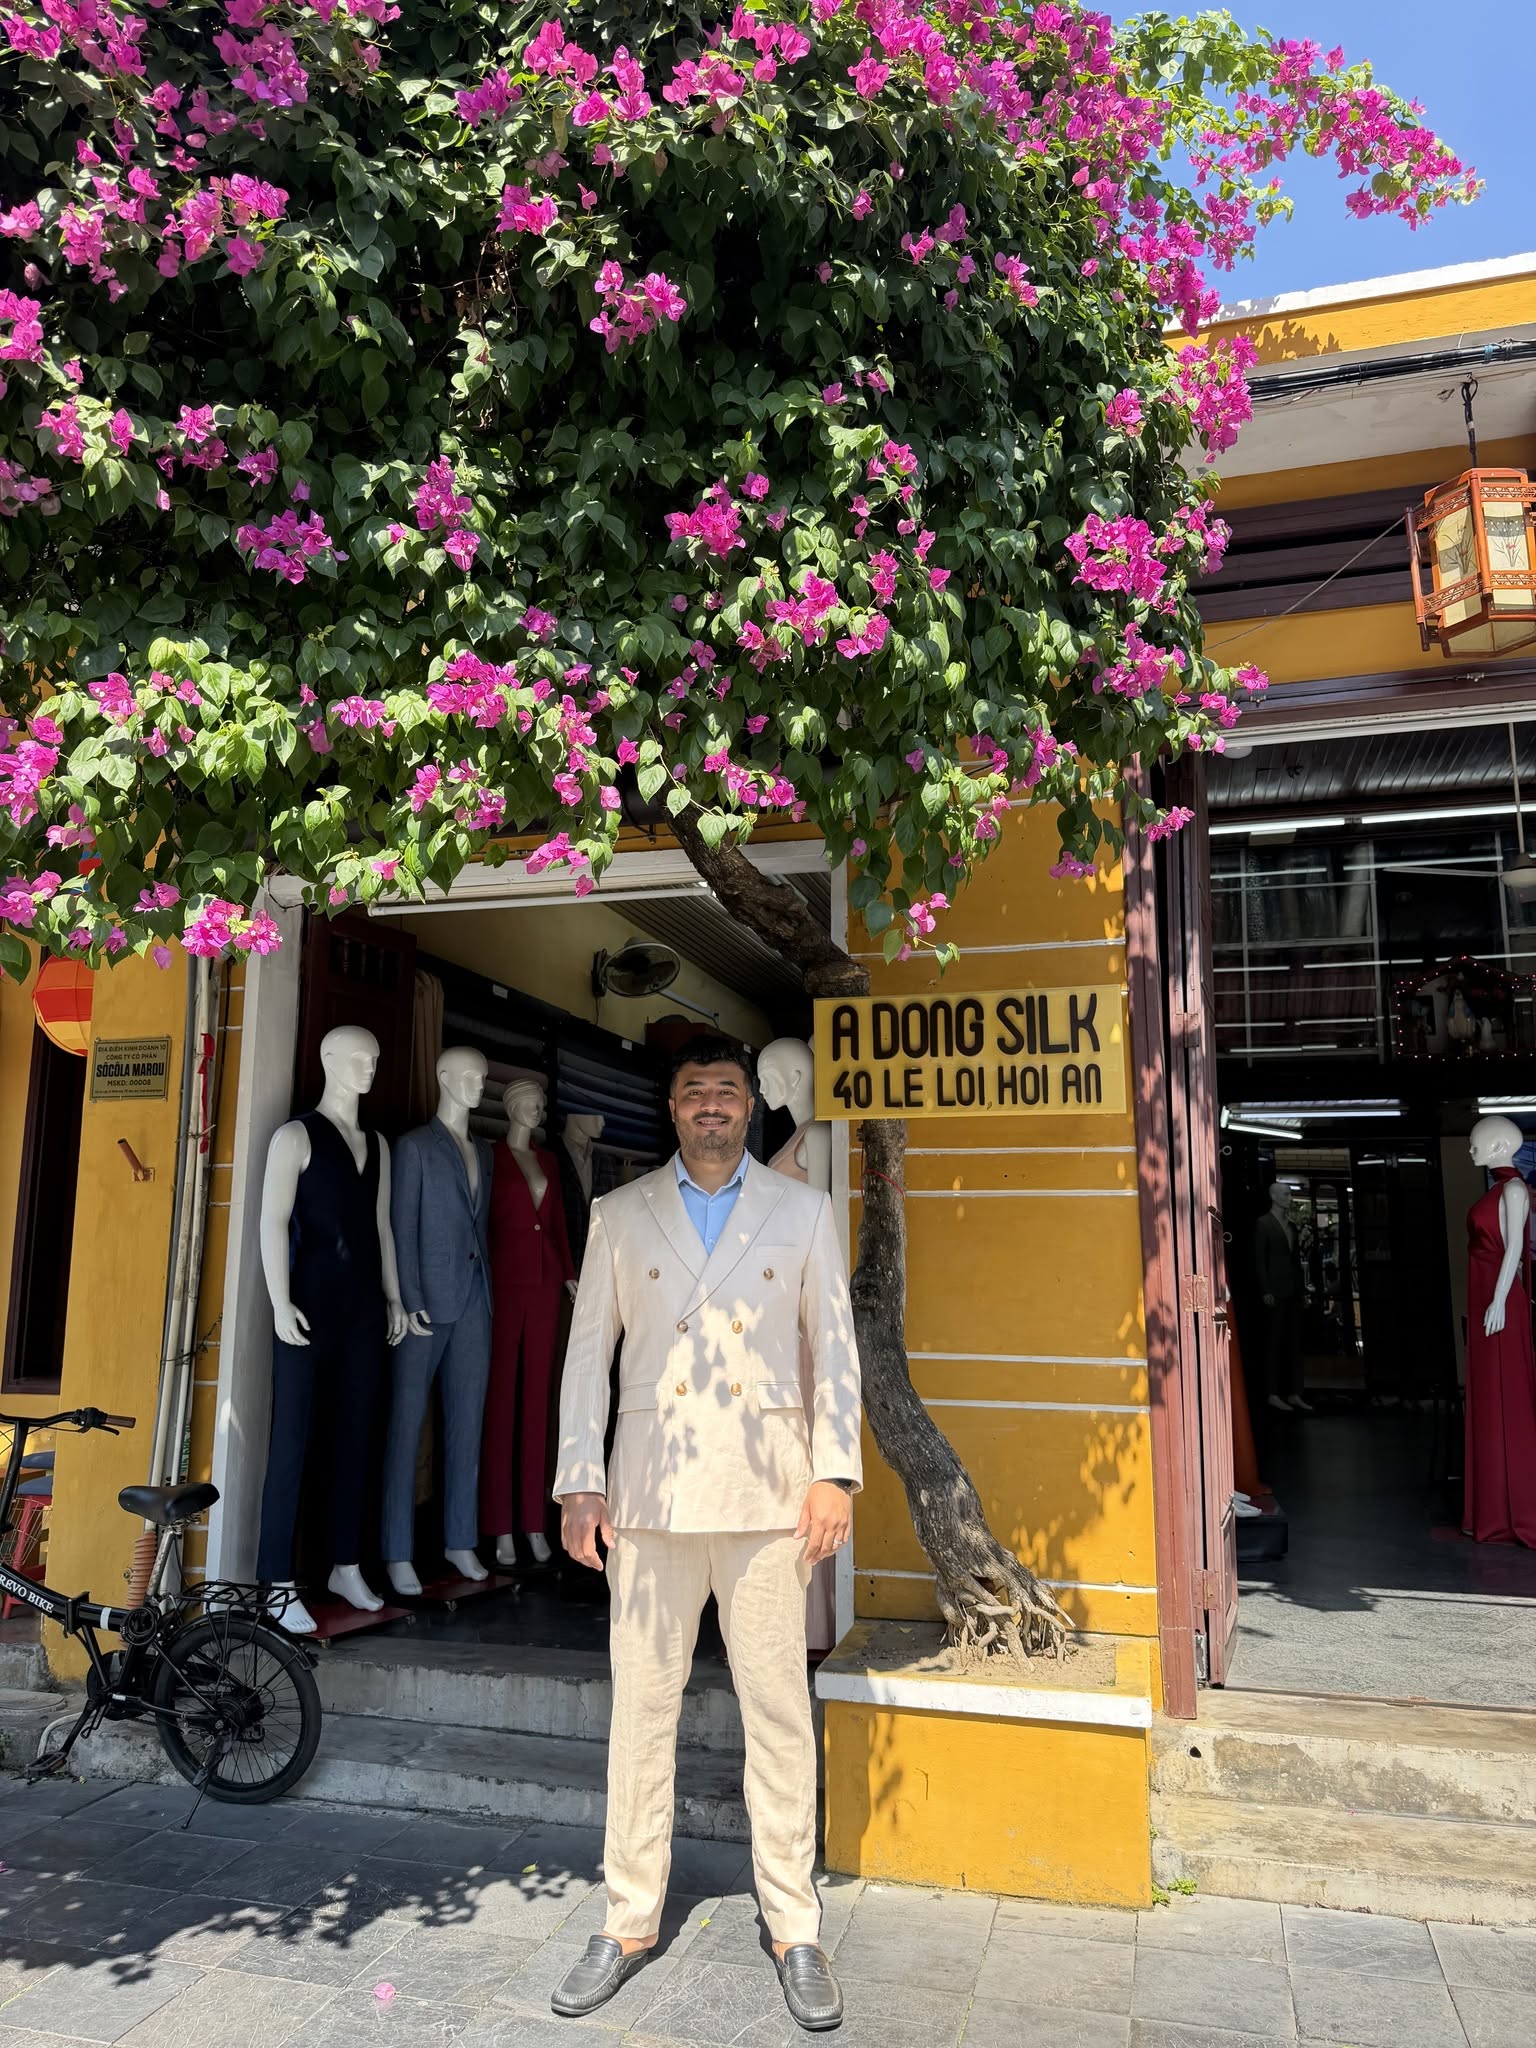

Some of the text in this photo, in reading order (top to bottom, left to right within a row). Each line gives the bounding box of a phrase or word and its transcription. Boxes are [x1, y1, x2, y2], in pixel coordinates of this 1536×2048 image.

[832, 993, 1101, 1061] A DONG SILK
[96, 1062, 164, 1077] SÔCÔLA MAROU
[833, 1070, 873, 1109] 40
[884, 1068, 924, 1108] LE
[998, 1064, 1049, 1105] HOI
[1062, 1063, 1102, 1104] AN
[27, 1592, 54, 1613] BIKE
